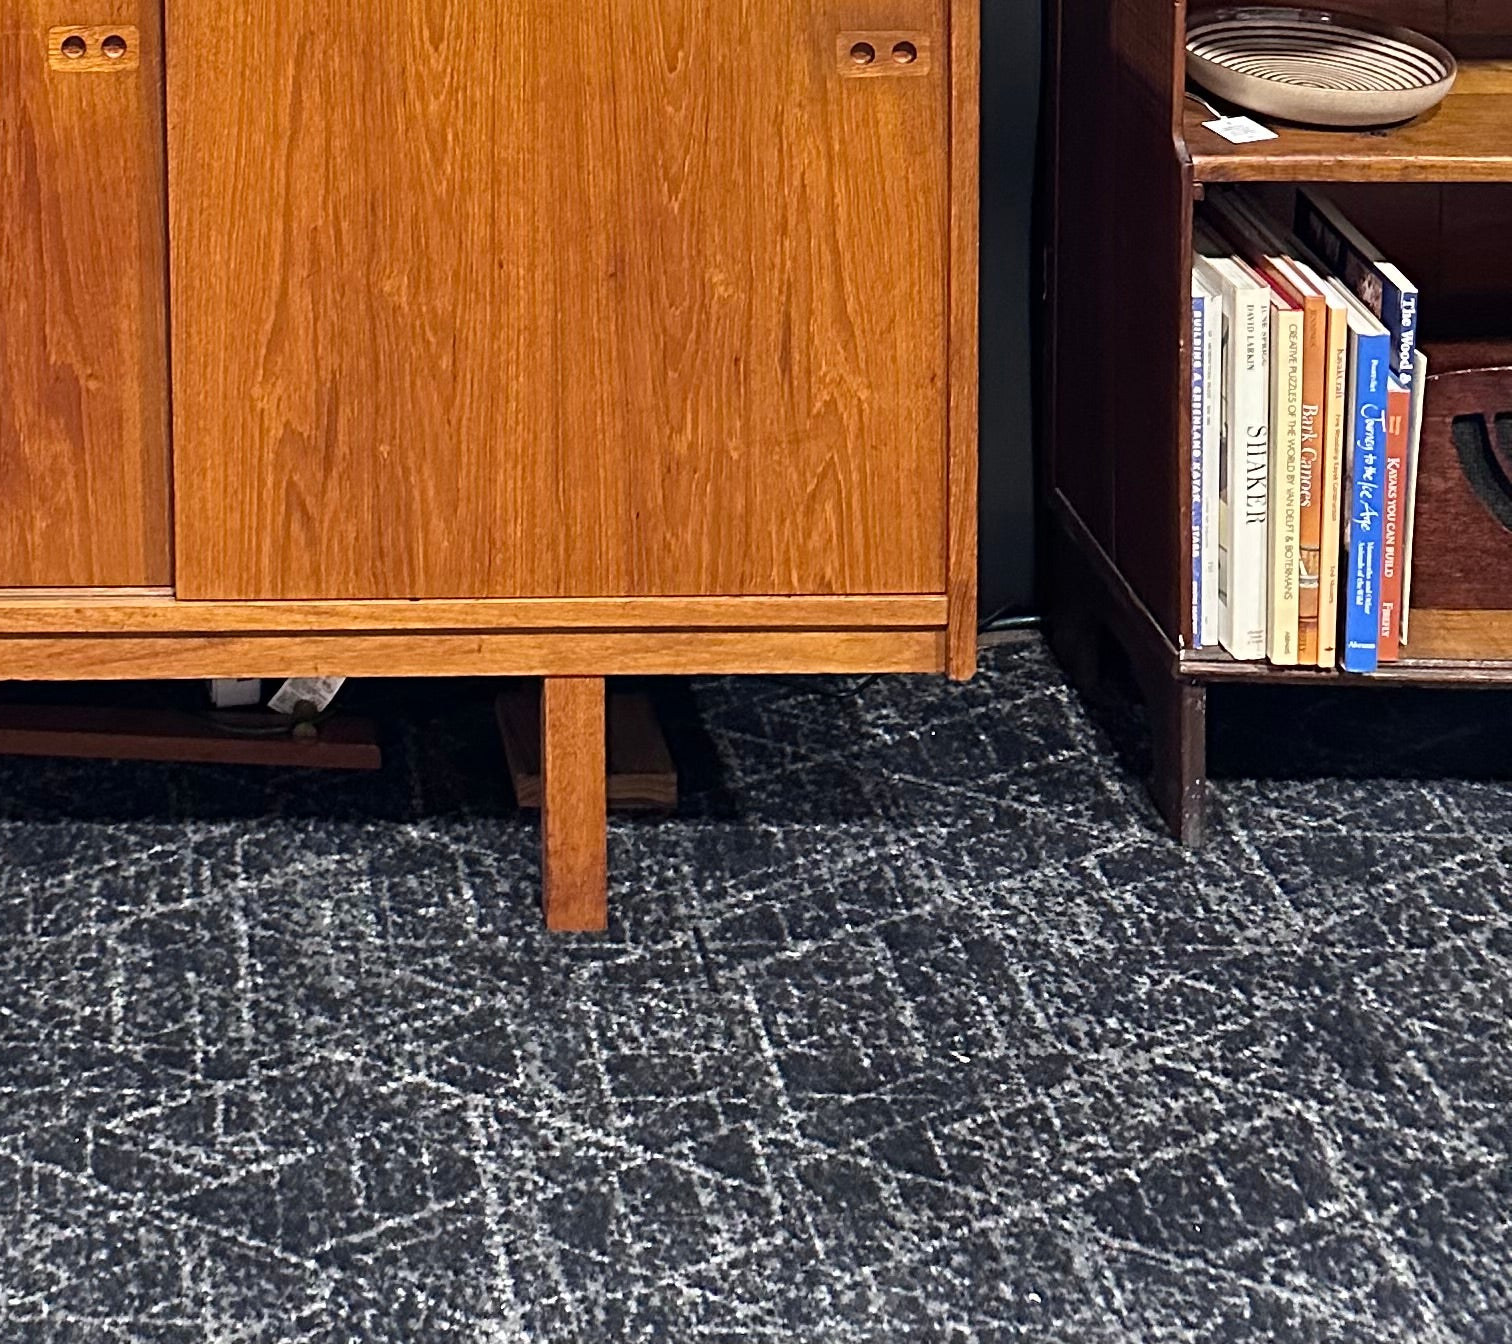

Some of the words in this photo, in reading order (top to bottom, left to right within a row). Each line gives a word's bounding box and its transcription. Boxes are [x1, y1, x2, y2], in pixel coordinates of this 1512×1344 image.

[1246, 304, 1255, 333] DAVID
[1402, 297, 1416, 327] The
[1193, 310, 1202, 368] BUILDING
[1246, 335, 1255, 371] LARKIN
[1288, 323, 1298, 364] CREATIVE
[1399, 330, 1414, 370] Wood
[1192, 372, 1202, 382] A
[1288, 366, 1297, 404] PUZZLES
[1399, 372, 1412, 385] &
[1192, 385, 1202, 458] GREENLAND
[1287, 404, 1296, 418] OF
[1302, 404, 1319, 443] Bark
[1357, 403, 1386, 451] Journey
[1287, 420, 1297, 437] THE
[1286, 439, 1296, 473] WORLD
[1363, 453, 1378, 465] to
[1191, 461, 1201, 503] KAYAK
[1246, 425, 1267, 525] SHAKER
[1286, 474, 1296, 486] BY
[1300, 447, 1318, 508] Canoes
[1362, 466, 1377, 481] the
[1387, 457, 1400, 498] KAYAKS
[1286, 487, 1295, 507] VAN
[1356, 481, 1379, 499] Ice
[1285, 508, 1295, 534] DELFT
[1352, 499, 1379, 532] Age
[1386, 499, 1397, 521] YOU
[1284, 535, 1294, 543] &
[1385, 522, 1396, 545] CAN
[1283, 545, 1294, 600] BOTERMANS
[1384, 546, 1395, 578] BUILD
